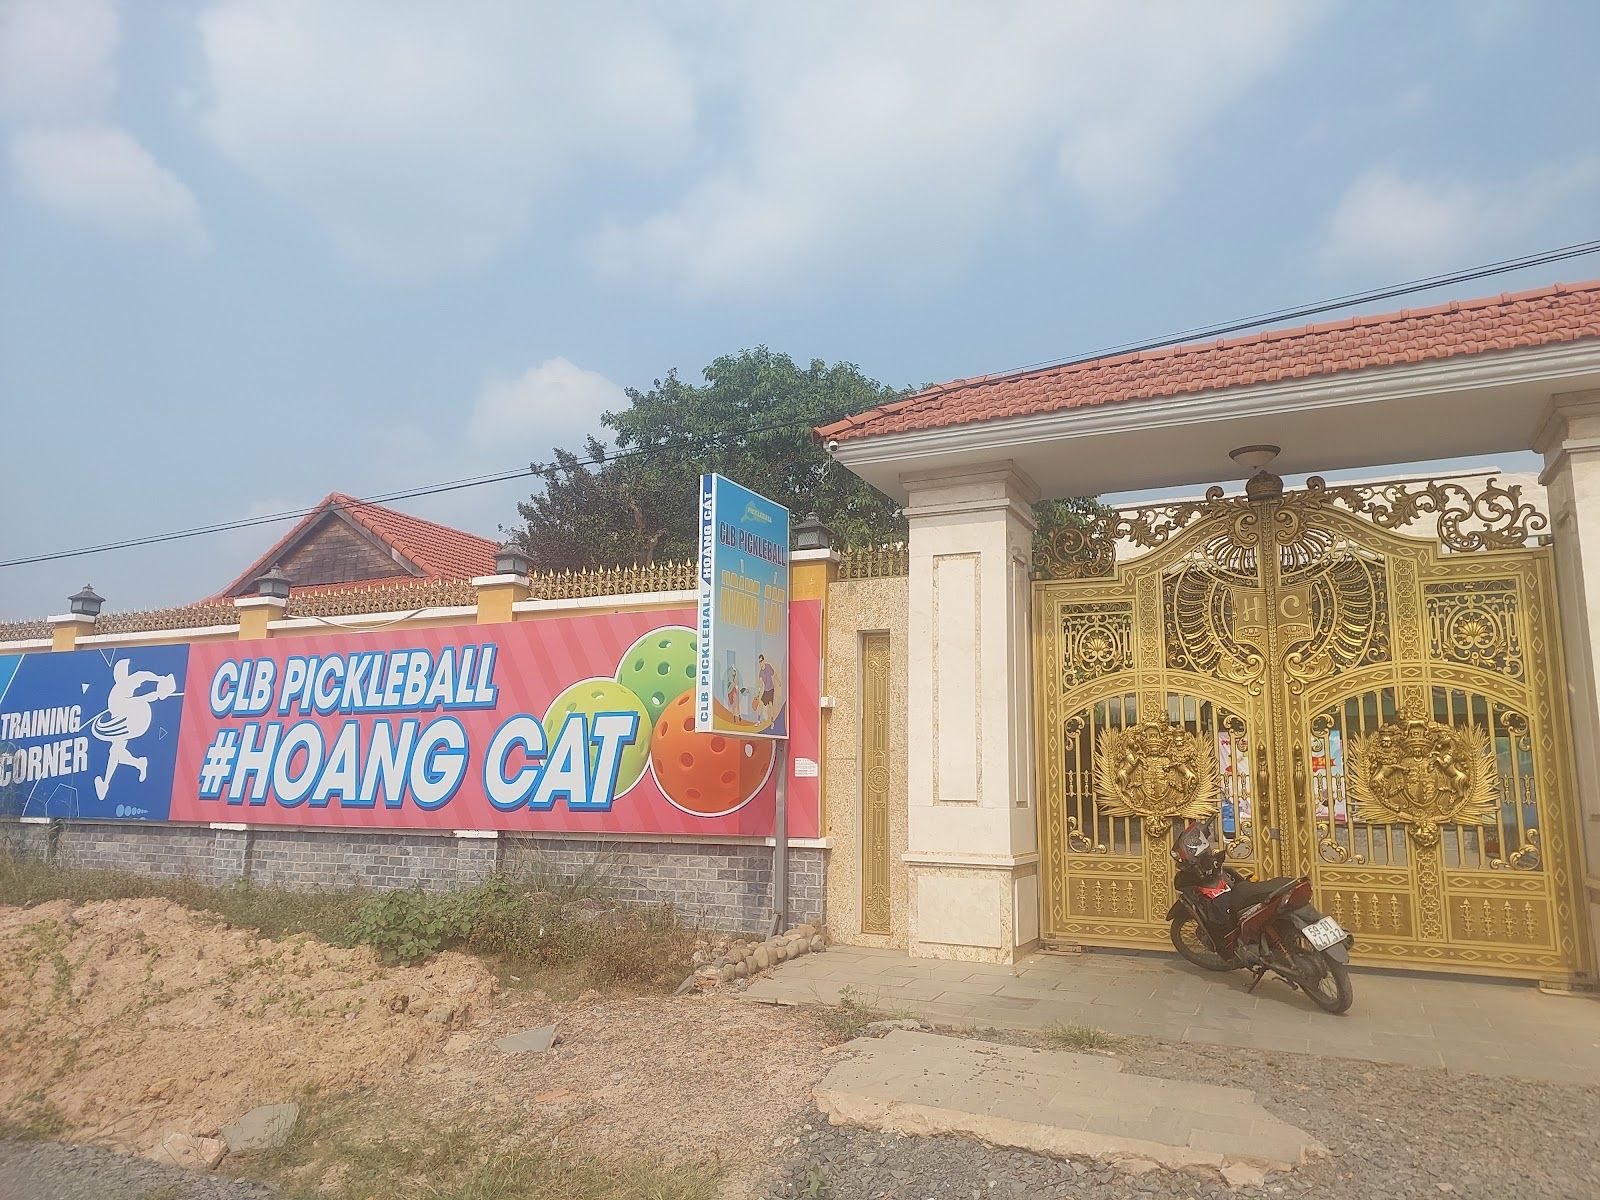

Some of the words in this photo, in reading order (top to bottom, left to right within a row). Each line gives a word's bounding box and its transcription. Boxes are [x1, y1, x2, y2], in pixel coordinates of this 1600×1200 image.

[719, 521, 736, 549] CLB
[738, 528, 785, 568] PICKLEBALL
[701, 590, 711, 686] PICKLEBALL
[210, 658, 276, 719] CLB
[277, 643, 499, 717] PICKLEBALL
[1, 705, 82, 740] TRAINING
[700, 691, 709, 722] CLB
[0, 737, 89, 787] CORNER
[199, 716, 469, 811] #HOANG
[483, 711, 640, 812] CAT
